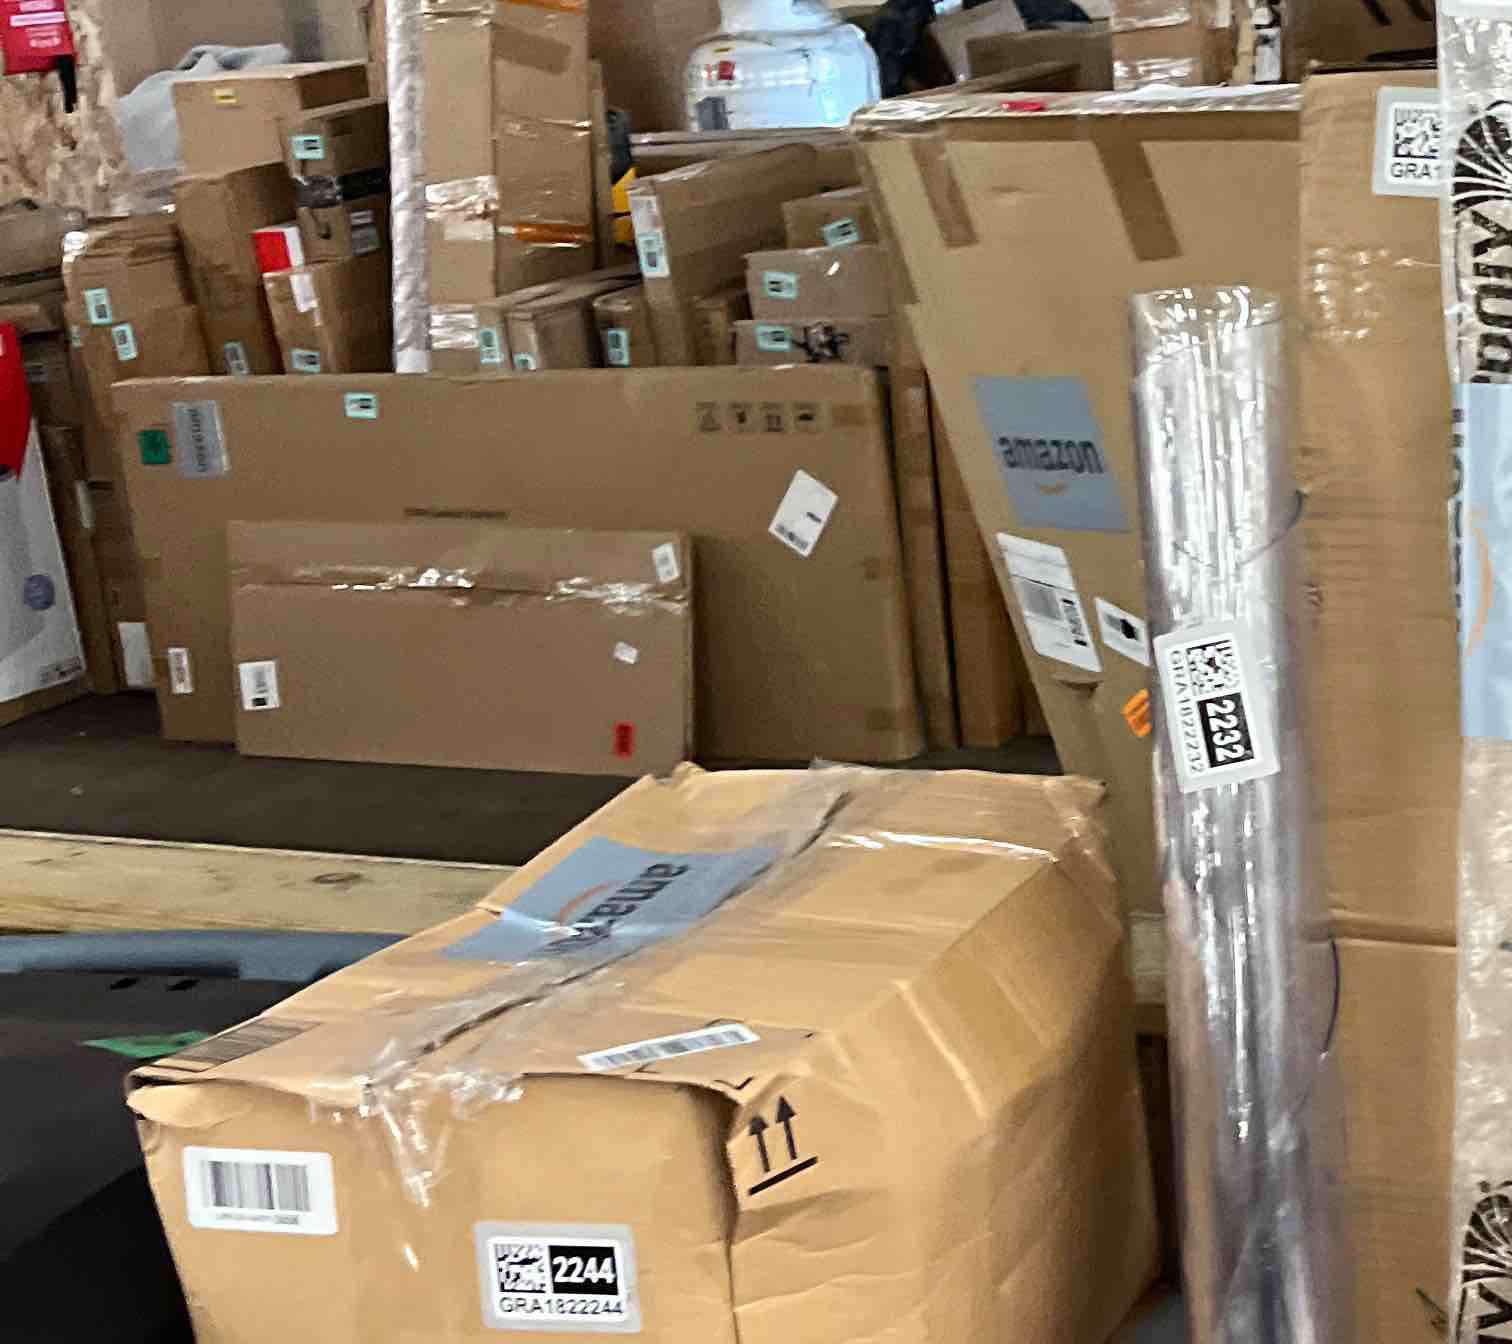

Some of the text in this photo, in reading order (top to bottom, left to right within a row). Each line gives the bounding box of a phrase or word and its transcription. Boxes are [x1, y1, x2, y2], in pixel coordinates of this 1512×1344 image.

[999, 436, 1102, 473] amazon
[1204, 696, 1246, 765] 2232
[553, 1255, 616, 1284] 2244
